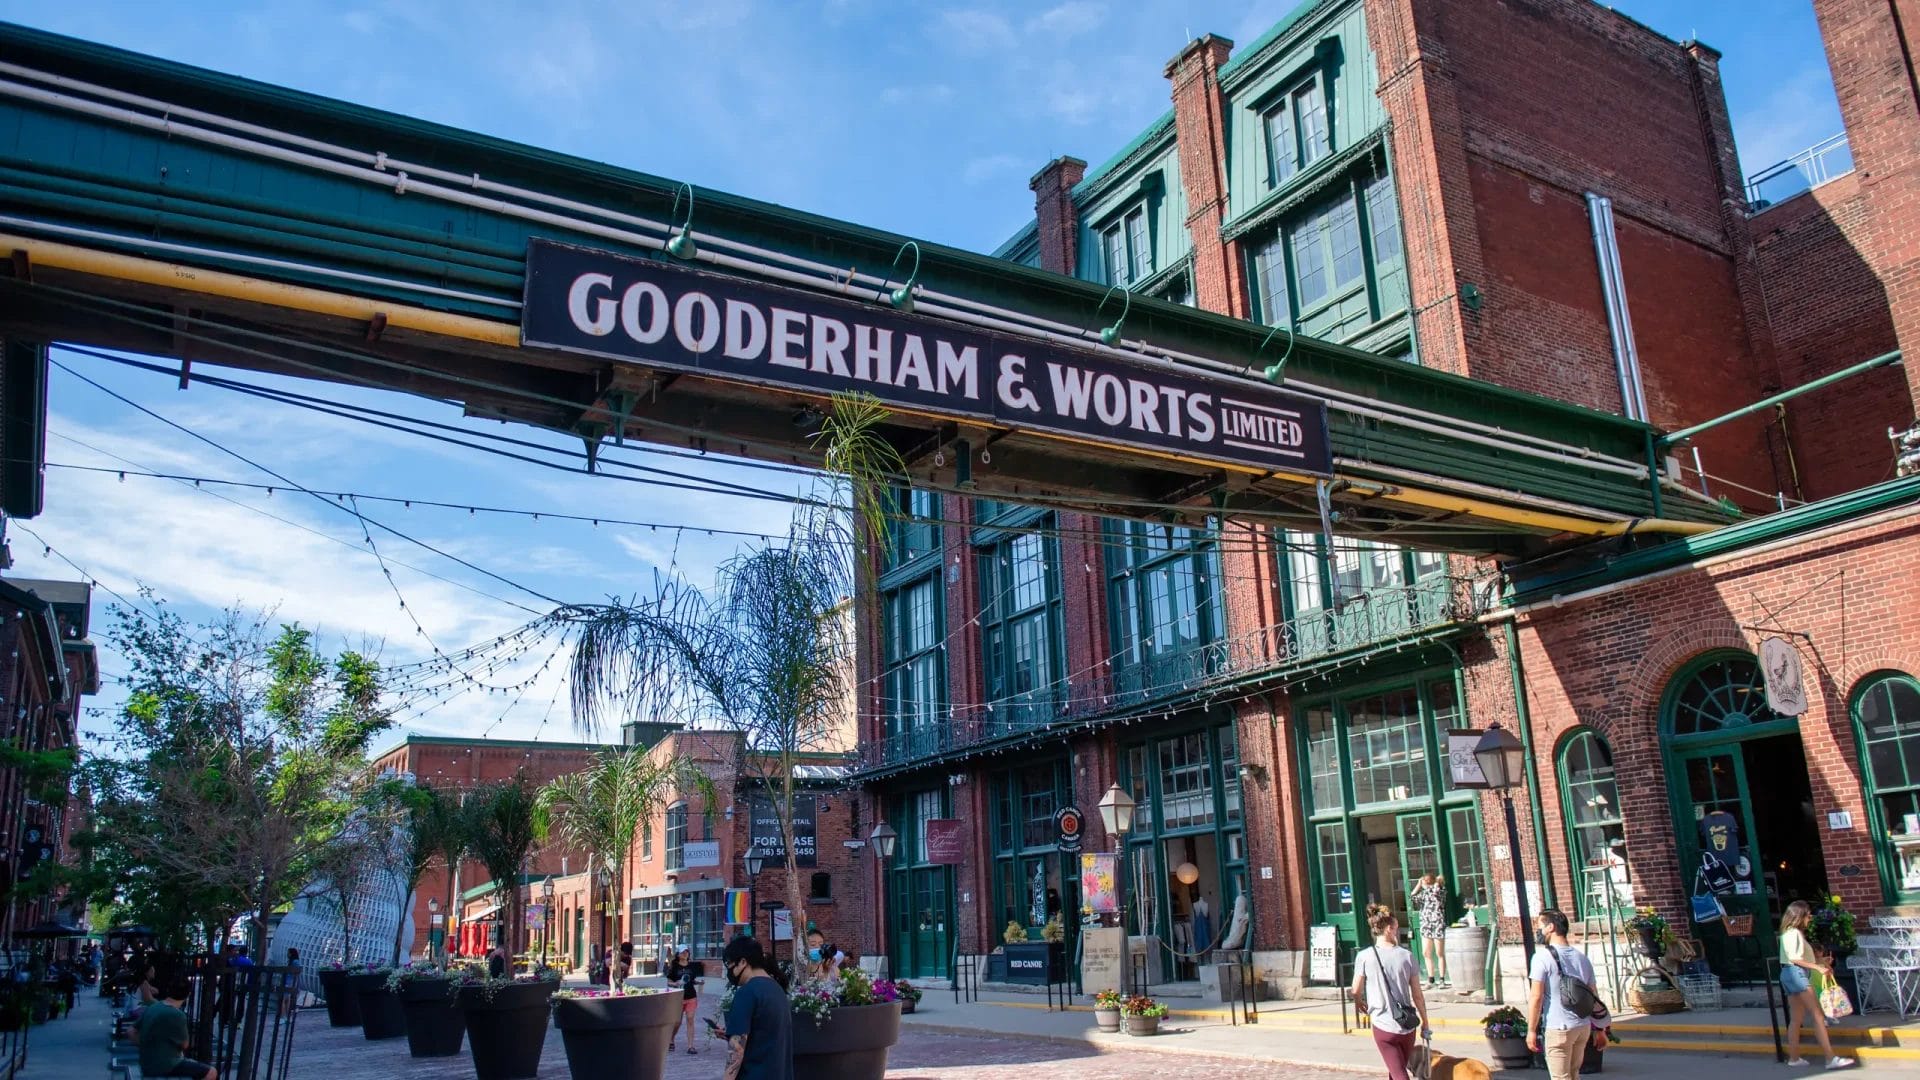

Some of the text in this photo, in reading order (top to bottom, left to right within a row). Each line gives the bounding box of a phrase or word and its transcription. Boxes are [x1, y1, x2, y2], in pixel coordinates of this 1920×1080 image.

[568, 272, 1303, 447] GOODERHAM & WORTS LIMITED
[1056, 808, 1066, 819] RED
[754, 836, 814, 846] FOR LASE
[1313, 947, 1333, 957] FREE
[1010, 960, 1043, 968] RED CANOE
